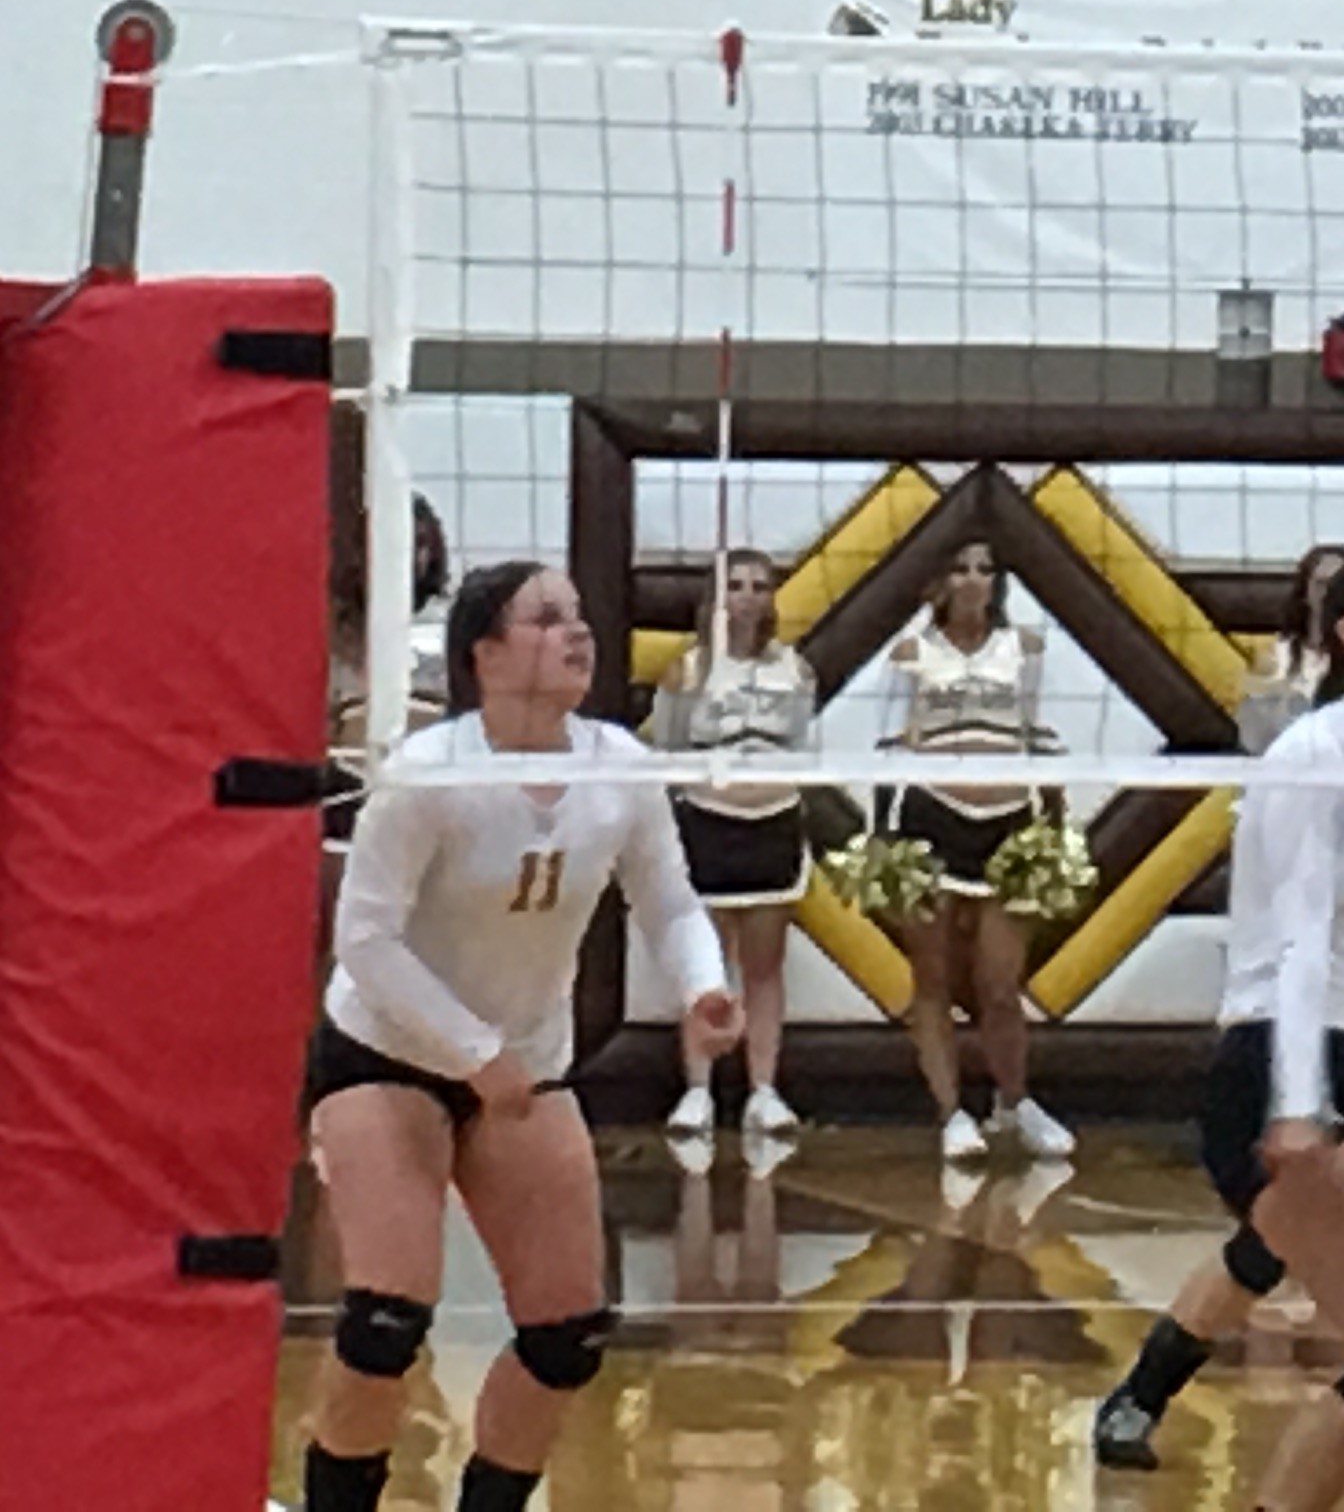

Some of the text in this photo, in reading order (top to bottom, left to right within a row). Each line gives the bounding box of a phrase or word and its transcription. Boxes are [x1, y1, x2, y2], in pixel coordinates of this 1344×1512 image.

[933, 83, 1053, 110] SUSAN
[1069, 86, 1153, 114] HILL
[507, 849, 566, 913] 11
